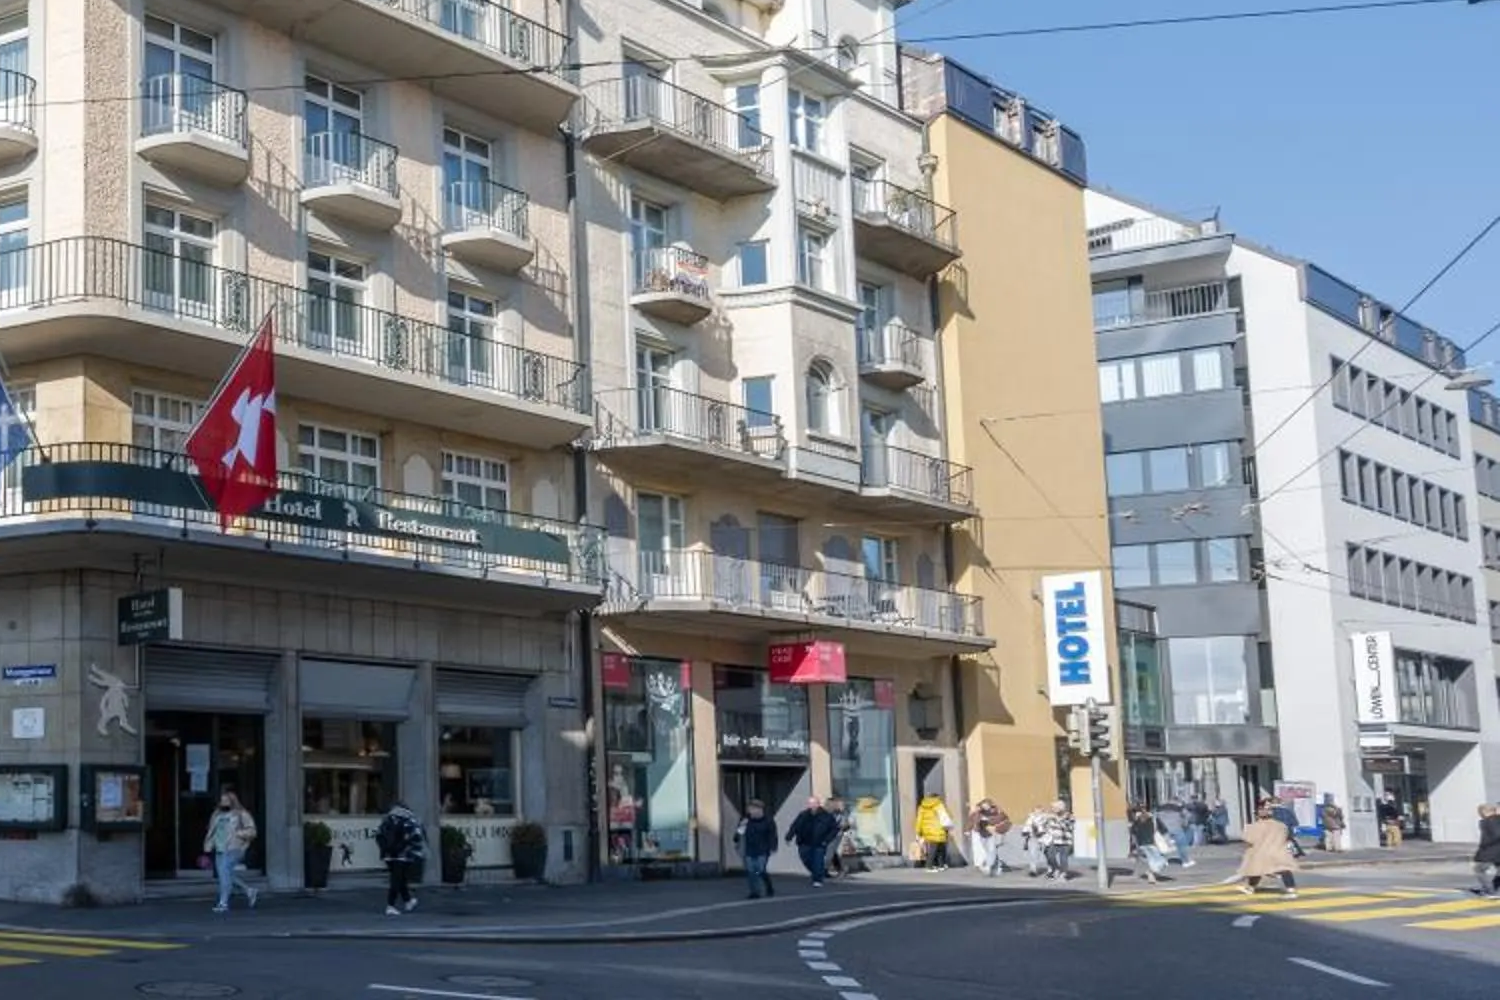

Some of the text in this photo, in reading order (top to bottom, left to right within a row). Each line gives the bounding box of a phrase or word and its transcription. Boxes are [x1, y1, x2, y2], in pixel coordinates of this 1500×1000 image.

[263, 493, 481, 544] Hotel Restaurant
[1054, 581, 1092, 686] HOTEL
